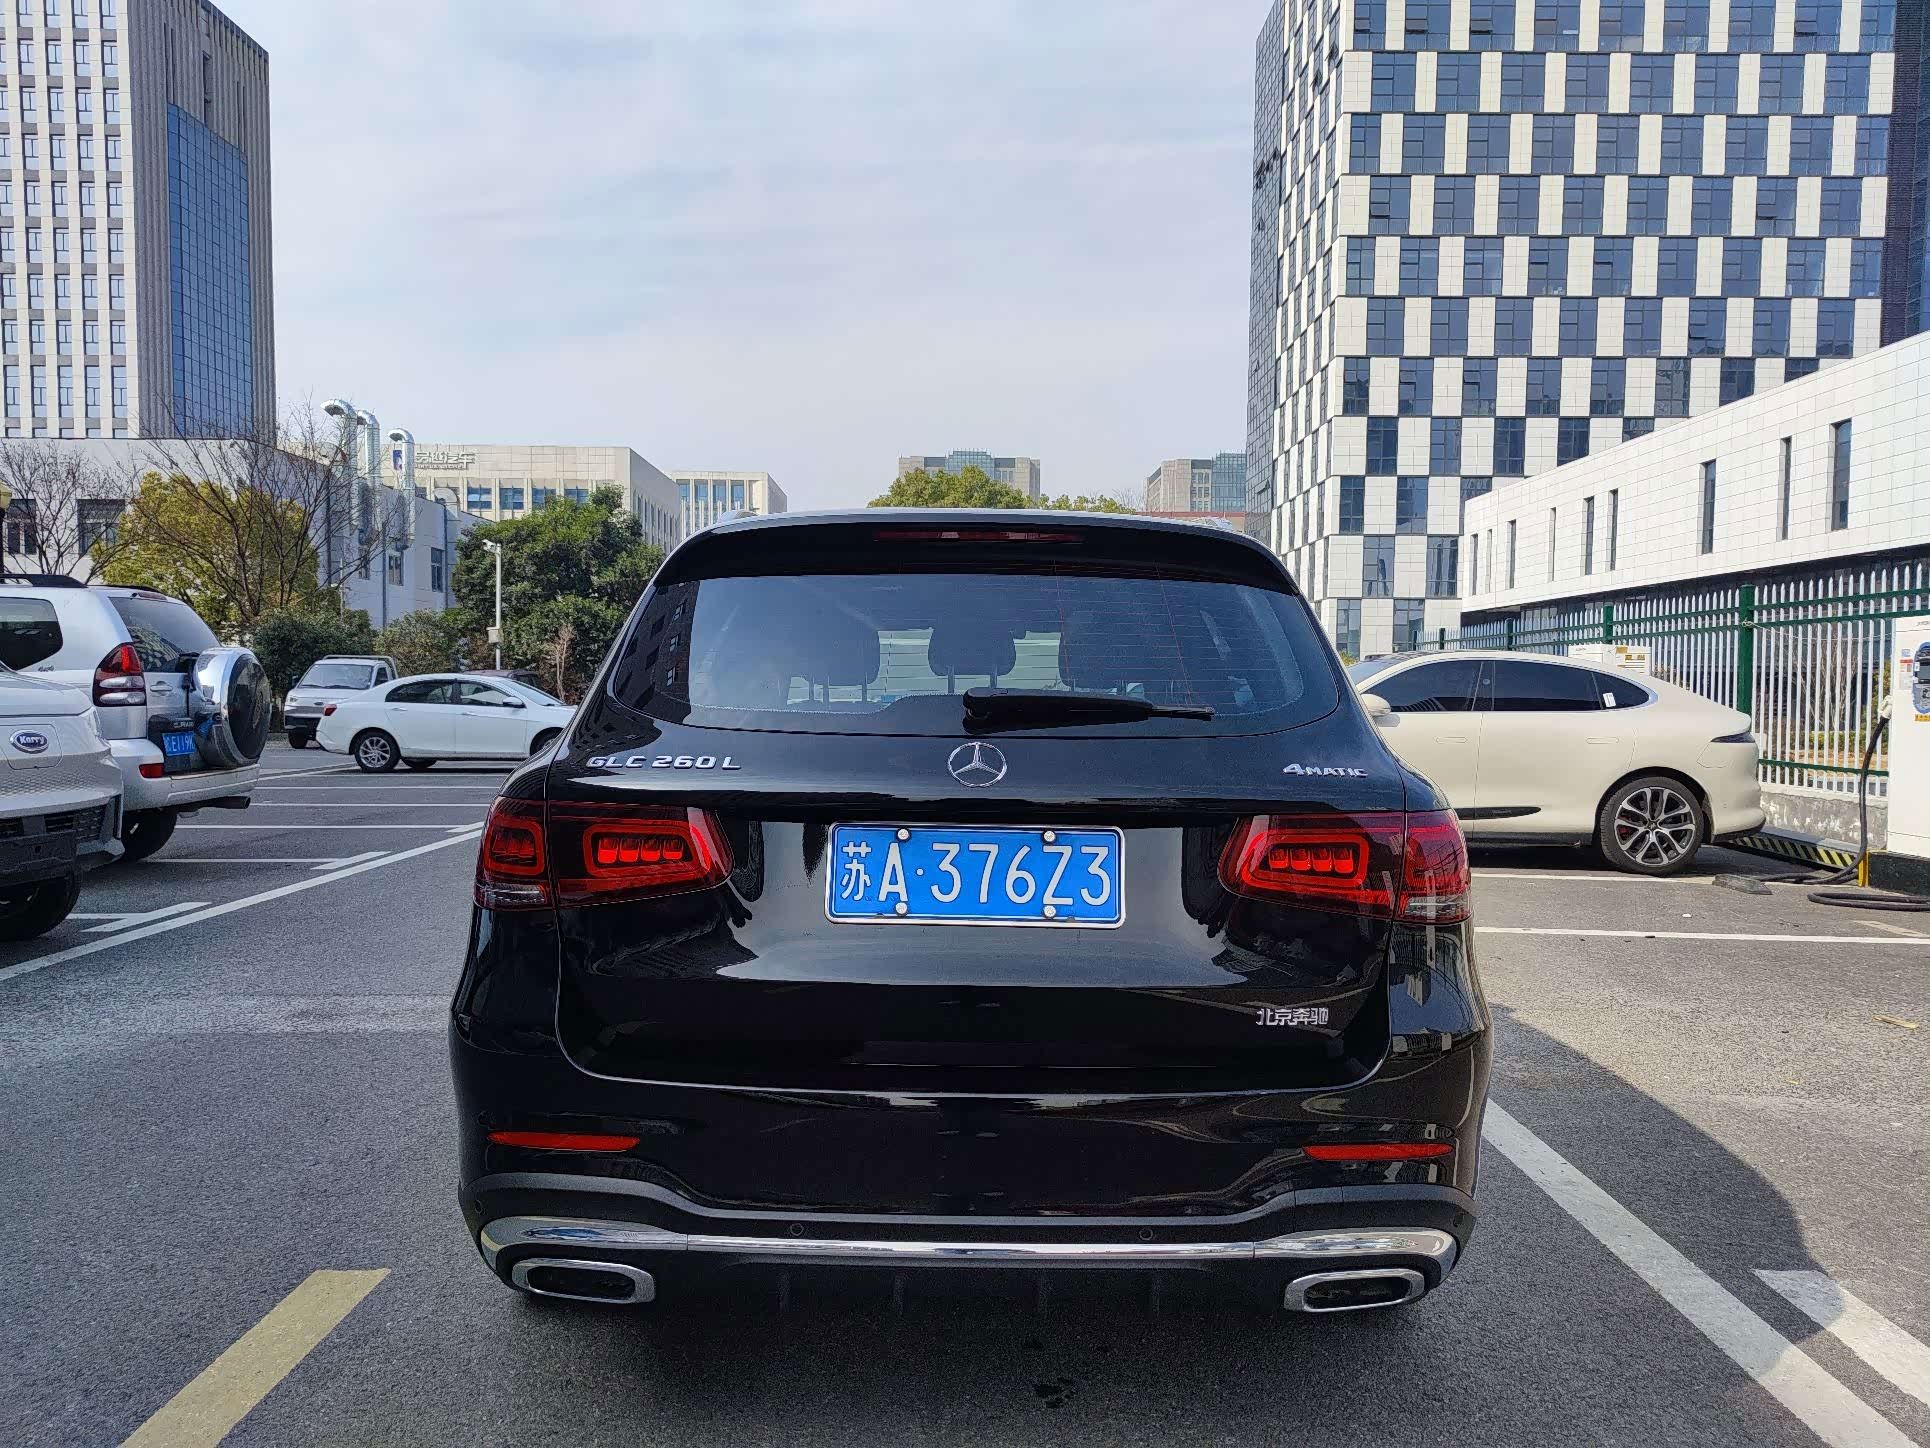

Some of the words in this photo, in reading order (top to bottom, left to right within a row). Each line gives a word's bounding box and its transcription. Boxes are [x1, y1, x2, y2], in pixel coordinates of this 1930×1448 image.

[19, 735, 45, 746] Karry
[586, 756, 647, 768] GLC
[651, 756, 717, 769] 260
[721, 756, 742, 769] L
[1282, 763, 1369, 778] 4MATIC
[1255, 1007, 1329, 1026] 北京奔驰
